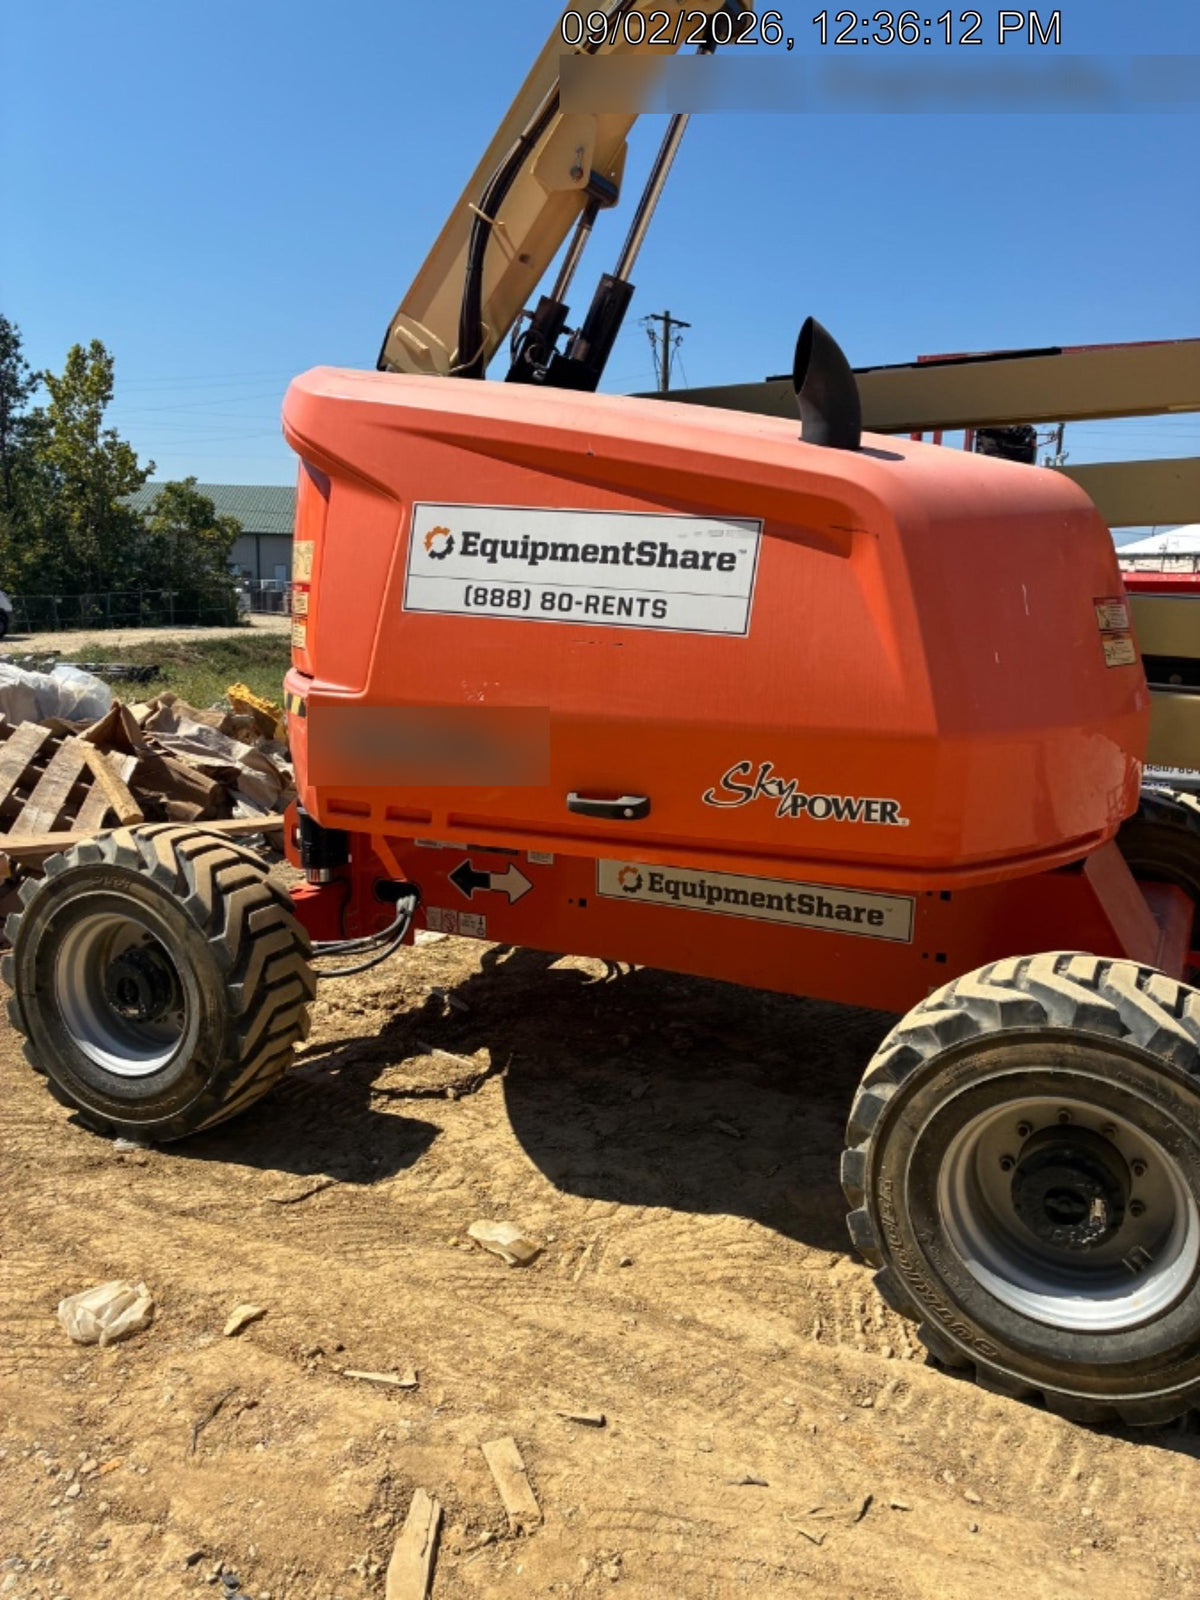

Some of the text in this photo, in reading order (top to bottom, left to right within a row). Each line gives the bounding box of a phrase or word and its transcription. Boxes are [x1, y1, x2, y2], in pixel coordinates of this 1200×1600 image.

[459, 531, 738, 572] EquipmentShare
[464, 584, 668, 619] (888) 80-RENTS
[648, 871, 885, 928] EquipmentShare
